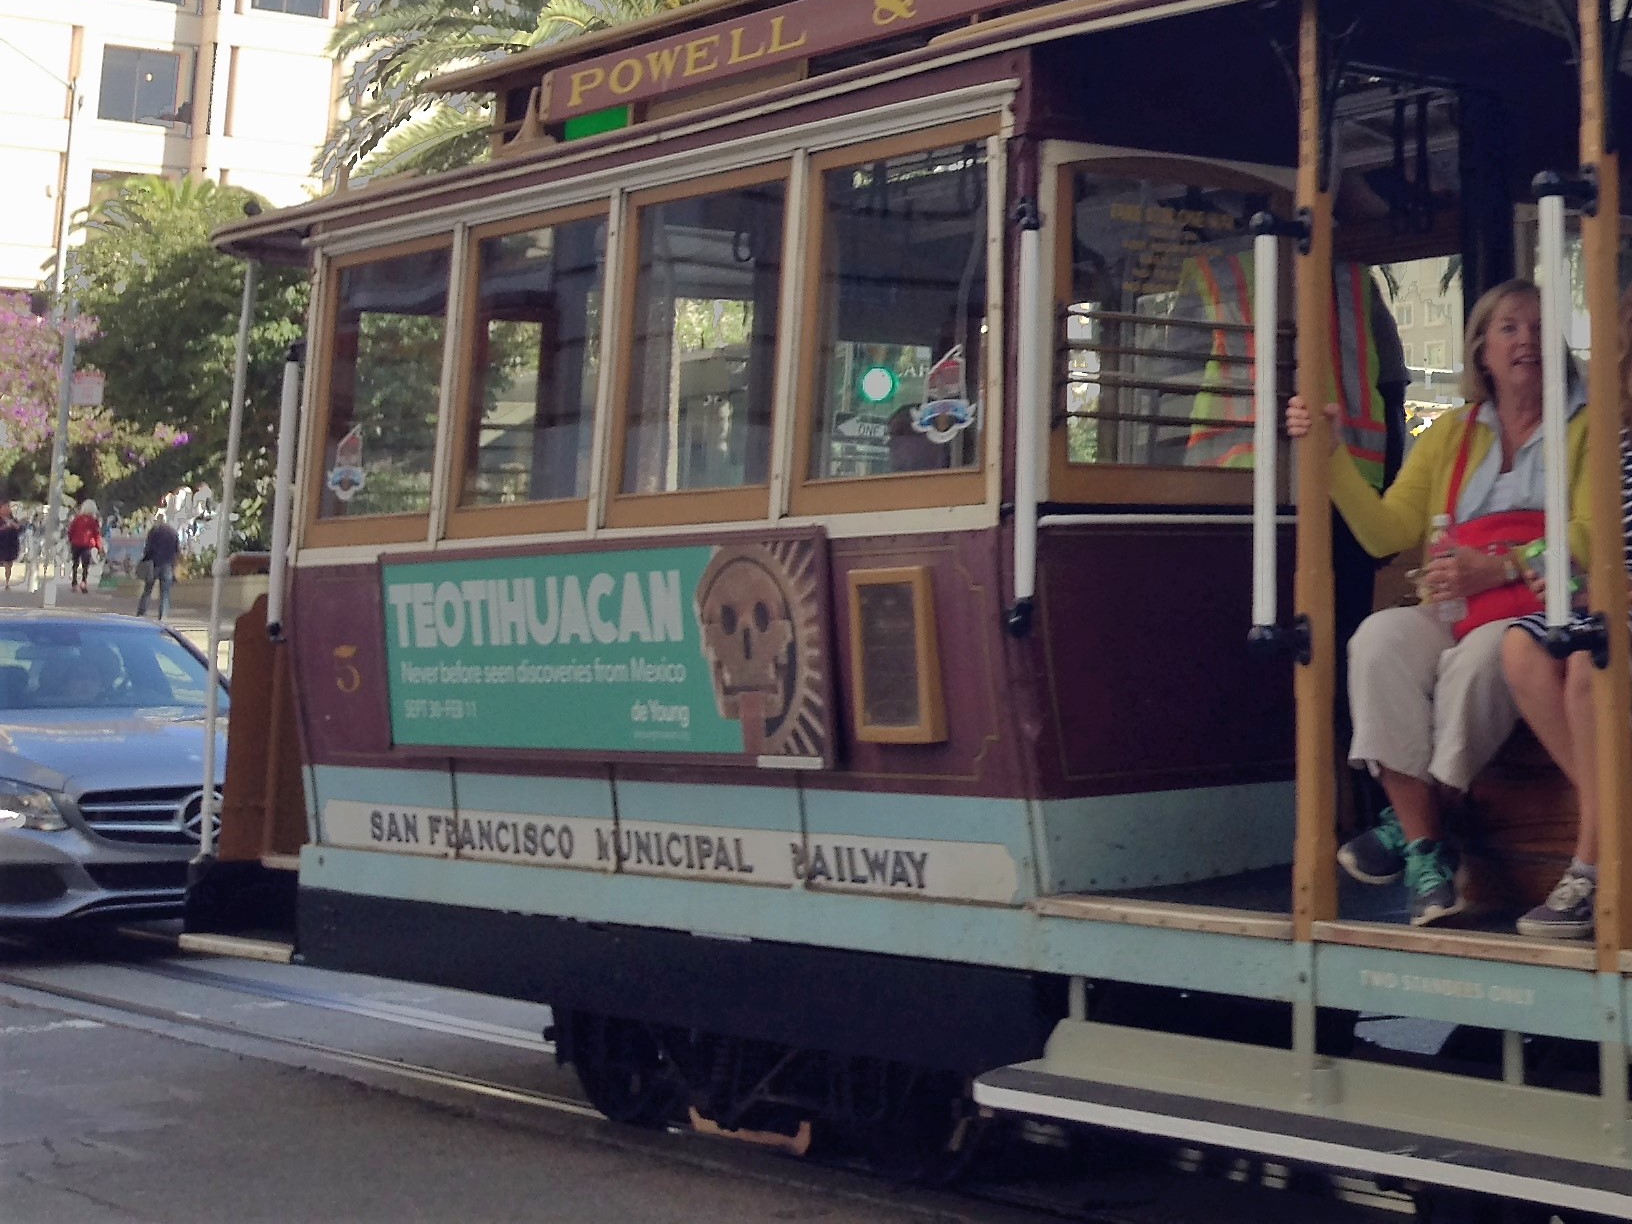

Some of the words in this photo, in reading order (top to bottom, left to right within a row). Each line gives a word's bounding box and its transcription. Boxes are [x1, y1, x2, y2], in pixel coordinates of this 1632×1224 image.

[567, 15, 808, 108] POWELL
[388, 568, 685, 648] TEOTIHUACAN
[630, 656, 687, 683] Mexico
[368, 809, 420, 844] SAN
[427, 814, 574, 860] FRANCISCO
